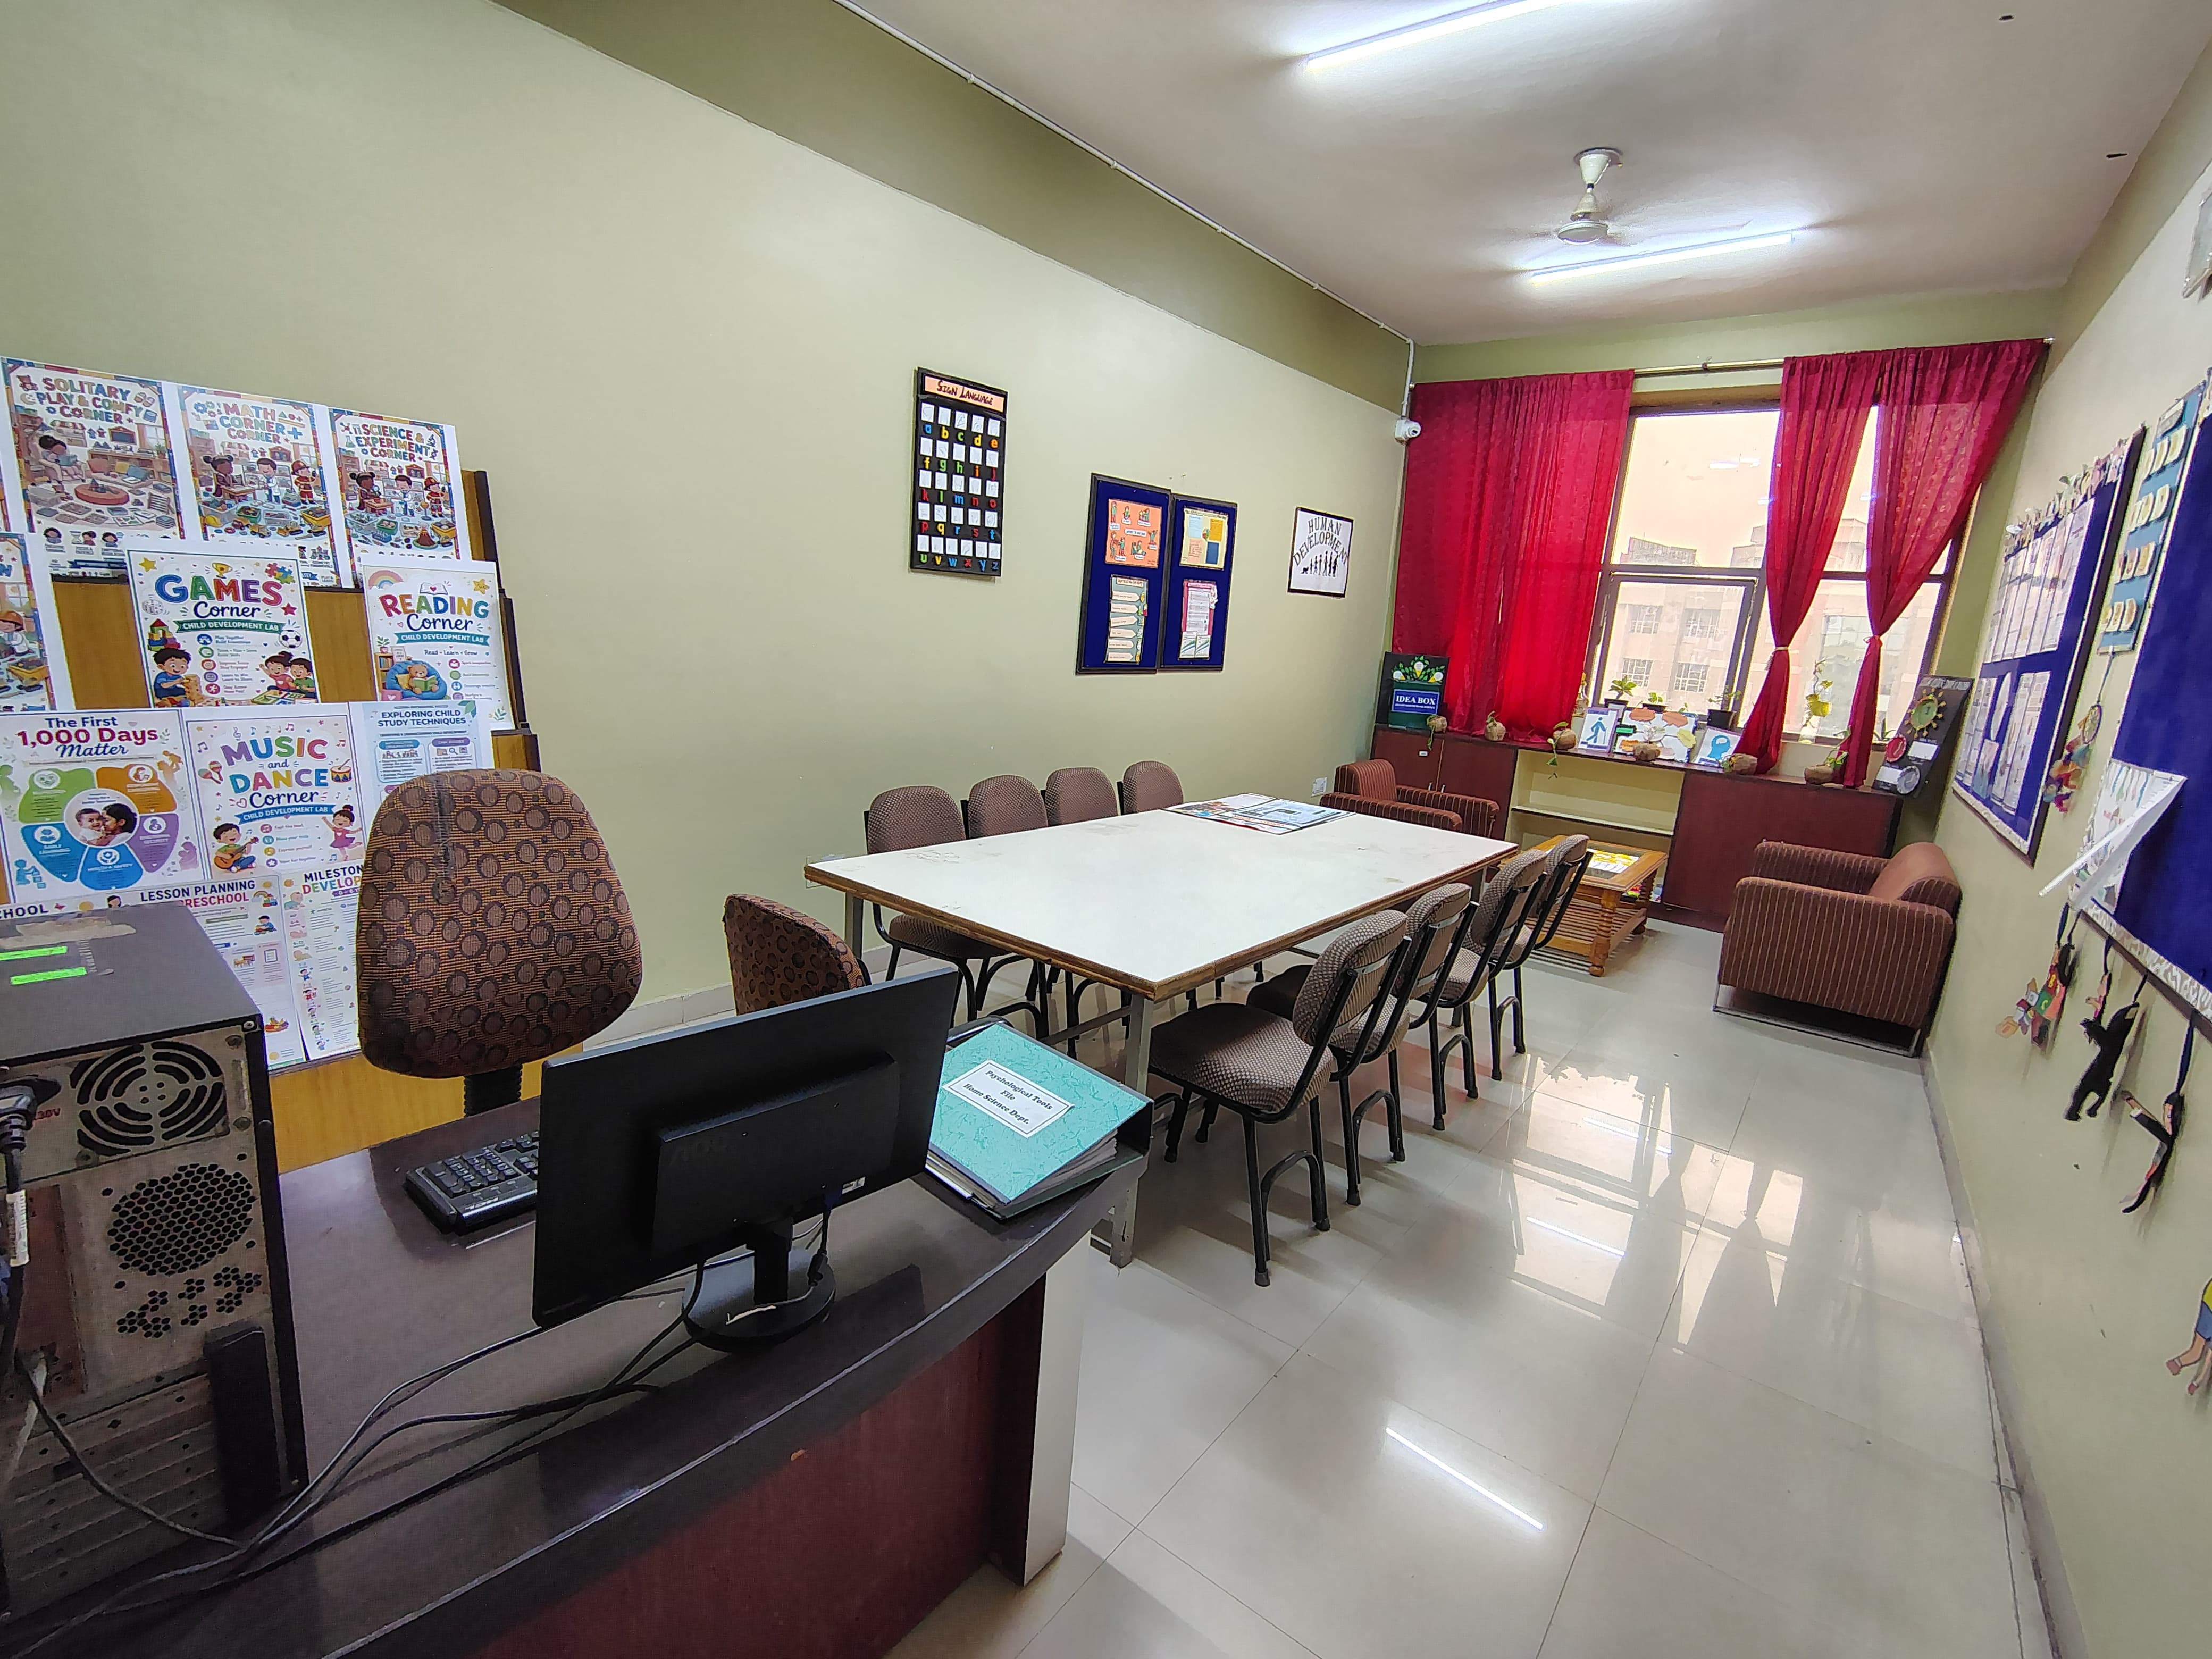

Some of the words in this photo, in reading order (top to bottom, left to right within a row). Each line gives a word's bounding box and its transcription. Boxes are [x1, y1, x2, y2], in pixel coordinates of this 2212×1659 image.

[42, 377, 131, 401] SOLITARY
[36, 392, 74, 405] PLAY
[60, 405, 124, 424] CORNER
[223, 403, 275, 421] MATH
[219, 416, 286, 435] CORNER
[362, 424, 413, 441] SCIENCE
[227, 428, 281, 445] CORNER
[355, 436, 431, 456] EXPERIMENT
[370, 448, 416, 462] CORNER
[1308, 516, 1342, 536] HUMAN
[155, 574, 283, 606] GAMES
[194, 601, 261, 618] Corner
[379, 594, 490, 619] READING
[208, 621, 263, 631] DEVELOPMENT
[407, 614, 473, 631] Corner
[1396, 695, 1416, 703] IDEA
[45, 717, 77, 728] The
[82, 716, 119, 727] First
[410, 717, 466, 726] TECHNIQUES
[16, 728, 90, 748] 1,000
[98, 727, 159, 745] Days
[55, 743, 129, 758] Matter
[221, 736, 328, 766] MUSIC
[267, 759, 289, 769] and
[229, 768, 329, 794] DANCE
[250, 792, 319, 808] Corner
[243, 811, 264, 821] CHILD
[265, 807, 314, 819] DEVELOPMENT
[140, 887, 190, 902] LESSON
[194, 880, 255, 895] PLANNING
[985, 1070, 1033, 1099] Psychological
[1032, 1095, 1053, 1110] Tools
[1000, 1090, 1016, 1101] File
[963, 1083, 984, 1096] Home
[983, 1094, 1010, 1112] Science
[1009, 1109, 1029, 1125] Dept.
